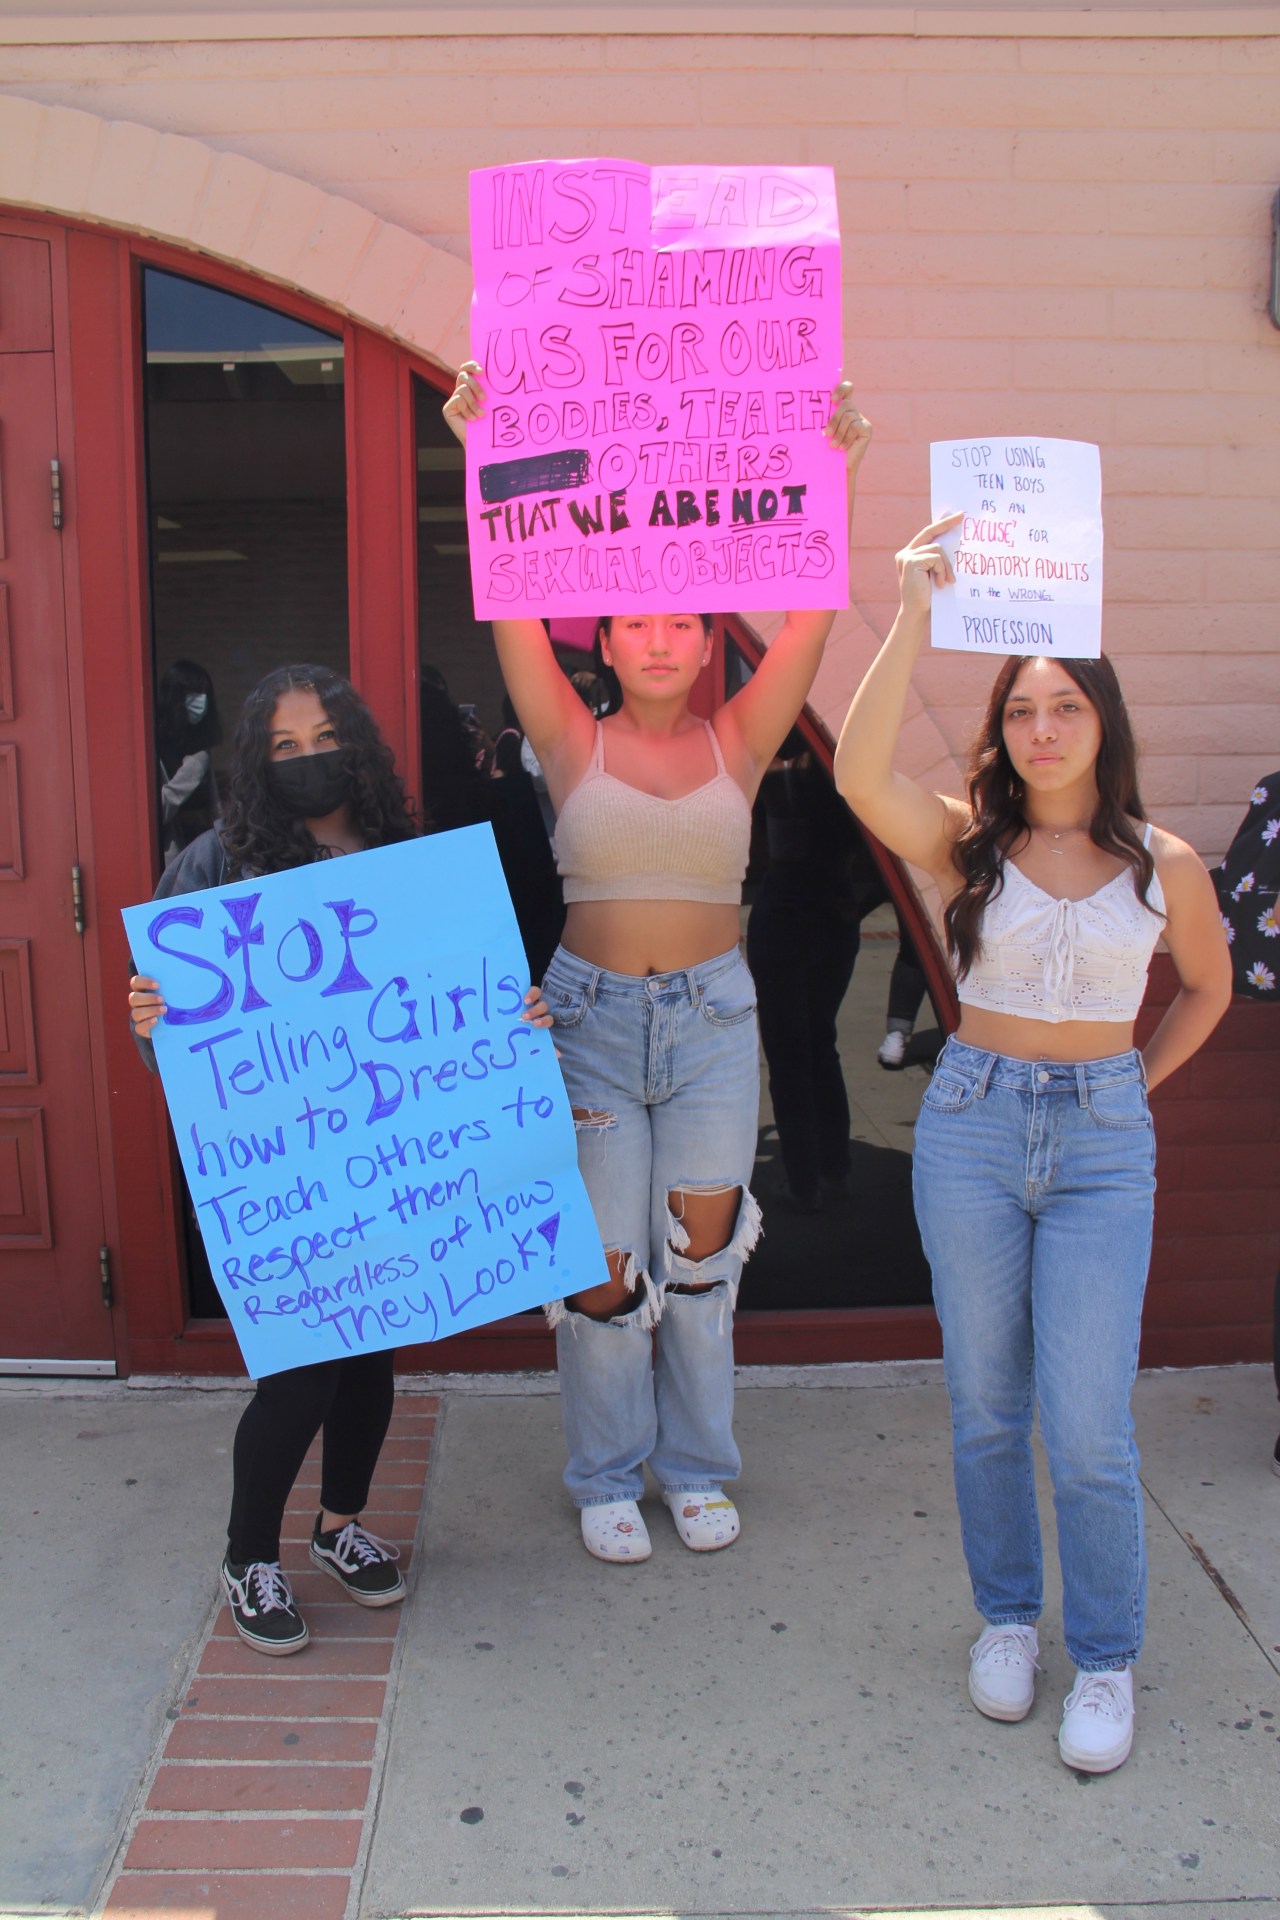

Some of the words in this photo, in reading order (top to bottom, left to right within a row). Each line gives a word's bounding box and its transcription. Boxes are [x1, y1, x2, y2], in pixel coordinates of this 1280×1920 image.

[493, 168, 818, 249] INSTEAD
[496, 265, 553, 307] OF
[558, 245, 823, 309] SHAMING
[485, 324, 586, 395] US
[599, 322, 709, 386] FOR
[720, 317, 818, 377] OUR
[492, 391, 668, 448] BODIES,
[680, 388, 832, 440] TEACH
[598, 441, 793, 492] OTHERS
[952, 445, 992, 468] STOP
[1005, 446, 1046, 469] USING
[974, 473, 1005, 491] TEEN
[1013, 476, 1045, 494] BOYS
[480, 497, 563, 542] THAT
[567, 489, 632, 537] WE
[648, 489, 721, 526] ARE
[731, 484, 807, 524] NOT
[981, 500, 997, 513] AS
[1008, 502, 1026, 514] AN
[1028, 528, 1050, 544] FOR
[487, 547, 658, 602] SEXUAL
[660, 530, 834, 594] OBJECTS
[954, 550, 1031, 577] PREDATORY
[1035, 557, 1089, 582] ADULTS
[986, 586, 1001, 598] the
[1007, 587, 1052, 602] WRONG
[962, 615, 1053, 645] PROFESSION
[189, 1022, 358, 1110] Telling
[368, 956, 523, 1044] Girls
[190, 1123, 285, 1177] how
[297, 1096, 348, 1149] to
[198, 1175, 329, 1245] Teach
[345, 1118, 492, 1189] Others
[502, 1086, 554, 1128] to
[222, 1211, 377, 1289] Respect
[387, 1168, 479, 1224] them
[244, 1254, 420, 1328] Regardless
[430, 1215, 472, 1262] of
[477, 1180, 554, 1234] how
[321, 1290, 438, 1350] They
